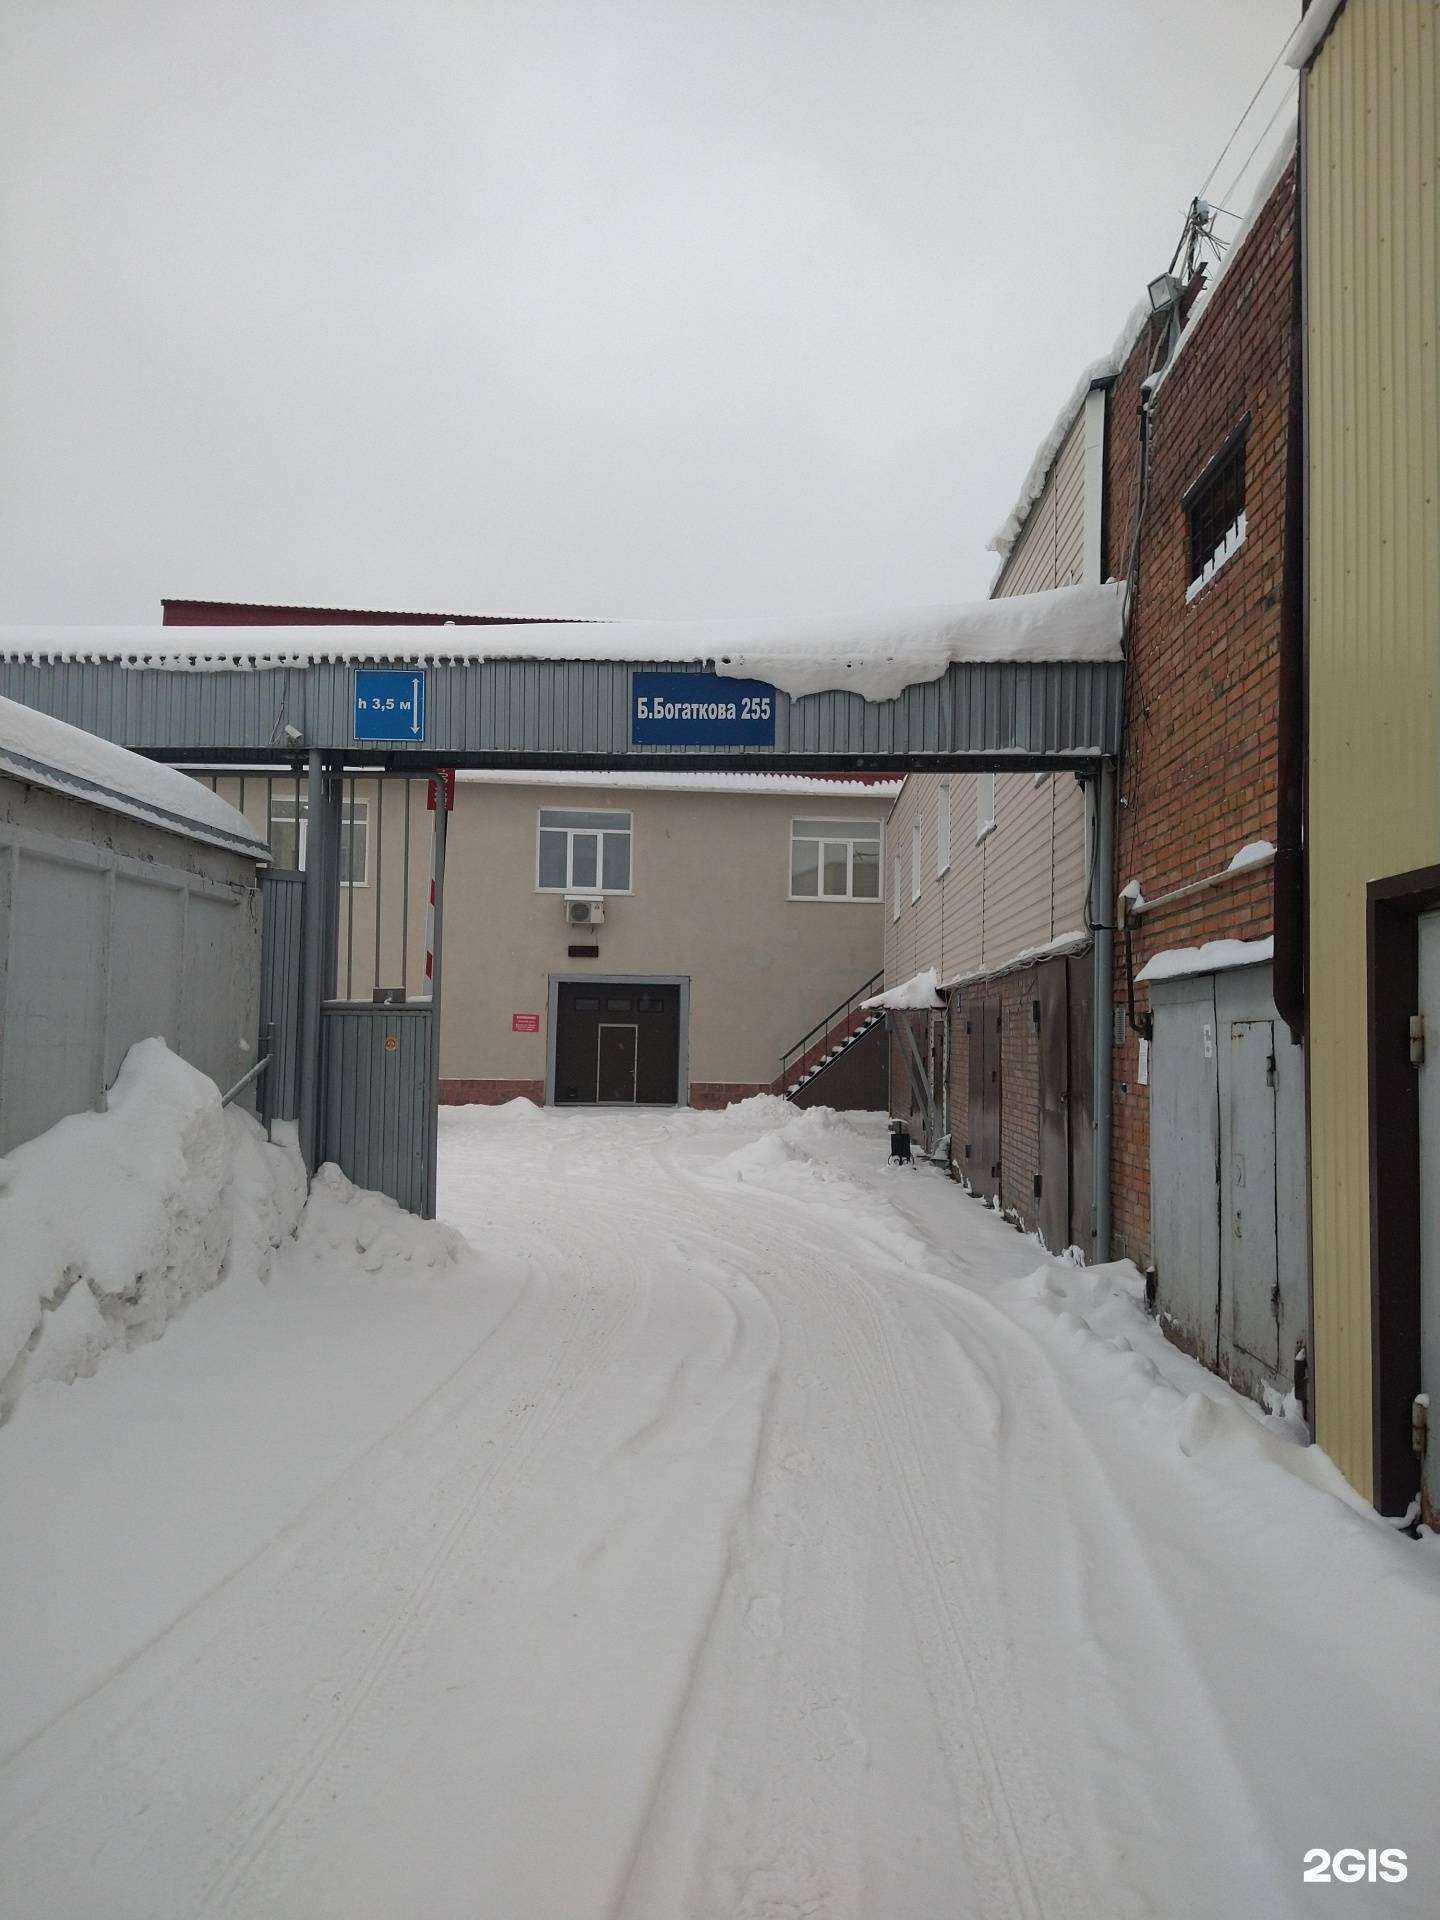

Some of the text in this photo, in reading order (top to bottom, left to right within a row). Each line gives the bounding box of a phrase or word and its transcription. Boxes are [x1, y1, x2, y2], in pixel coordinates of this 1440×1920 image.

[358, 697, 411, 712] h 3,5 м
[637, 697, 771, 720] Б.Богаткова 255
